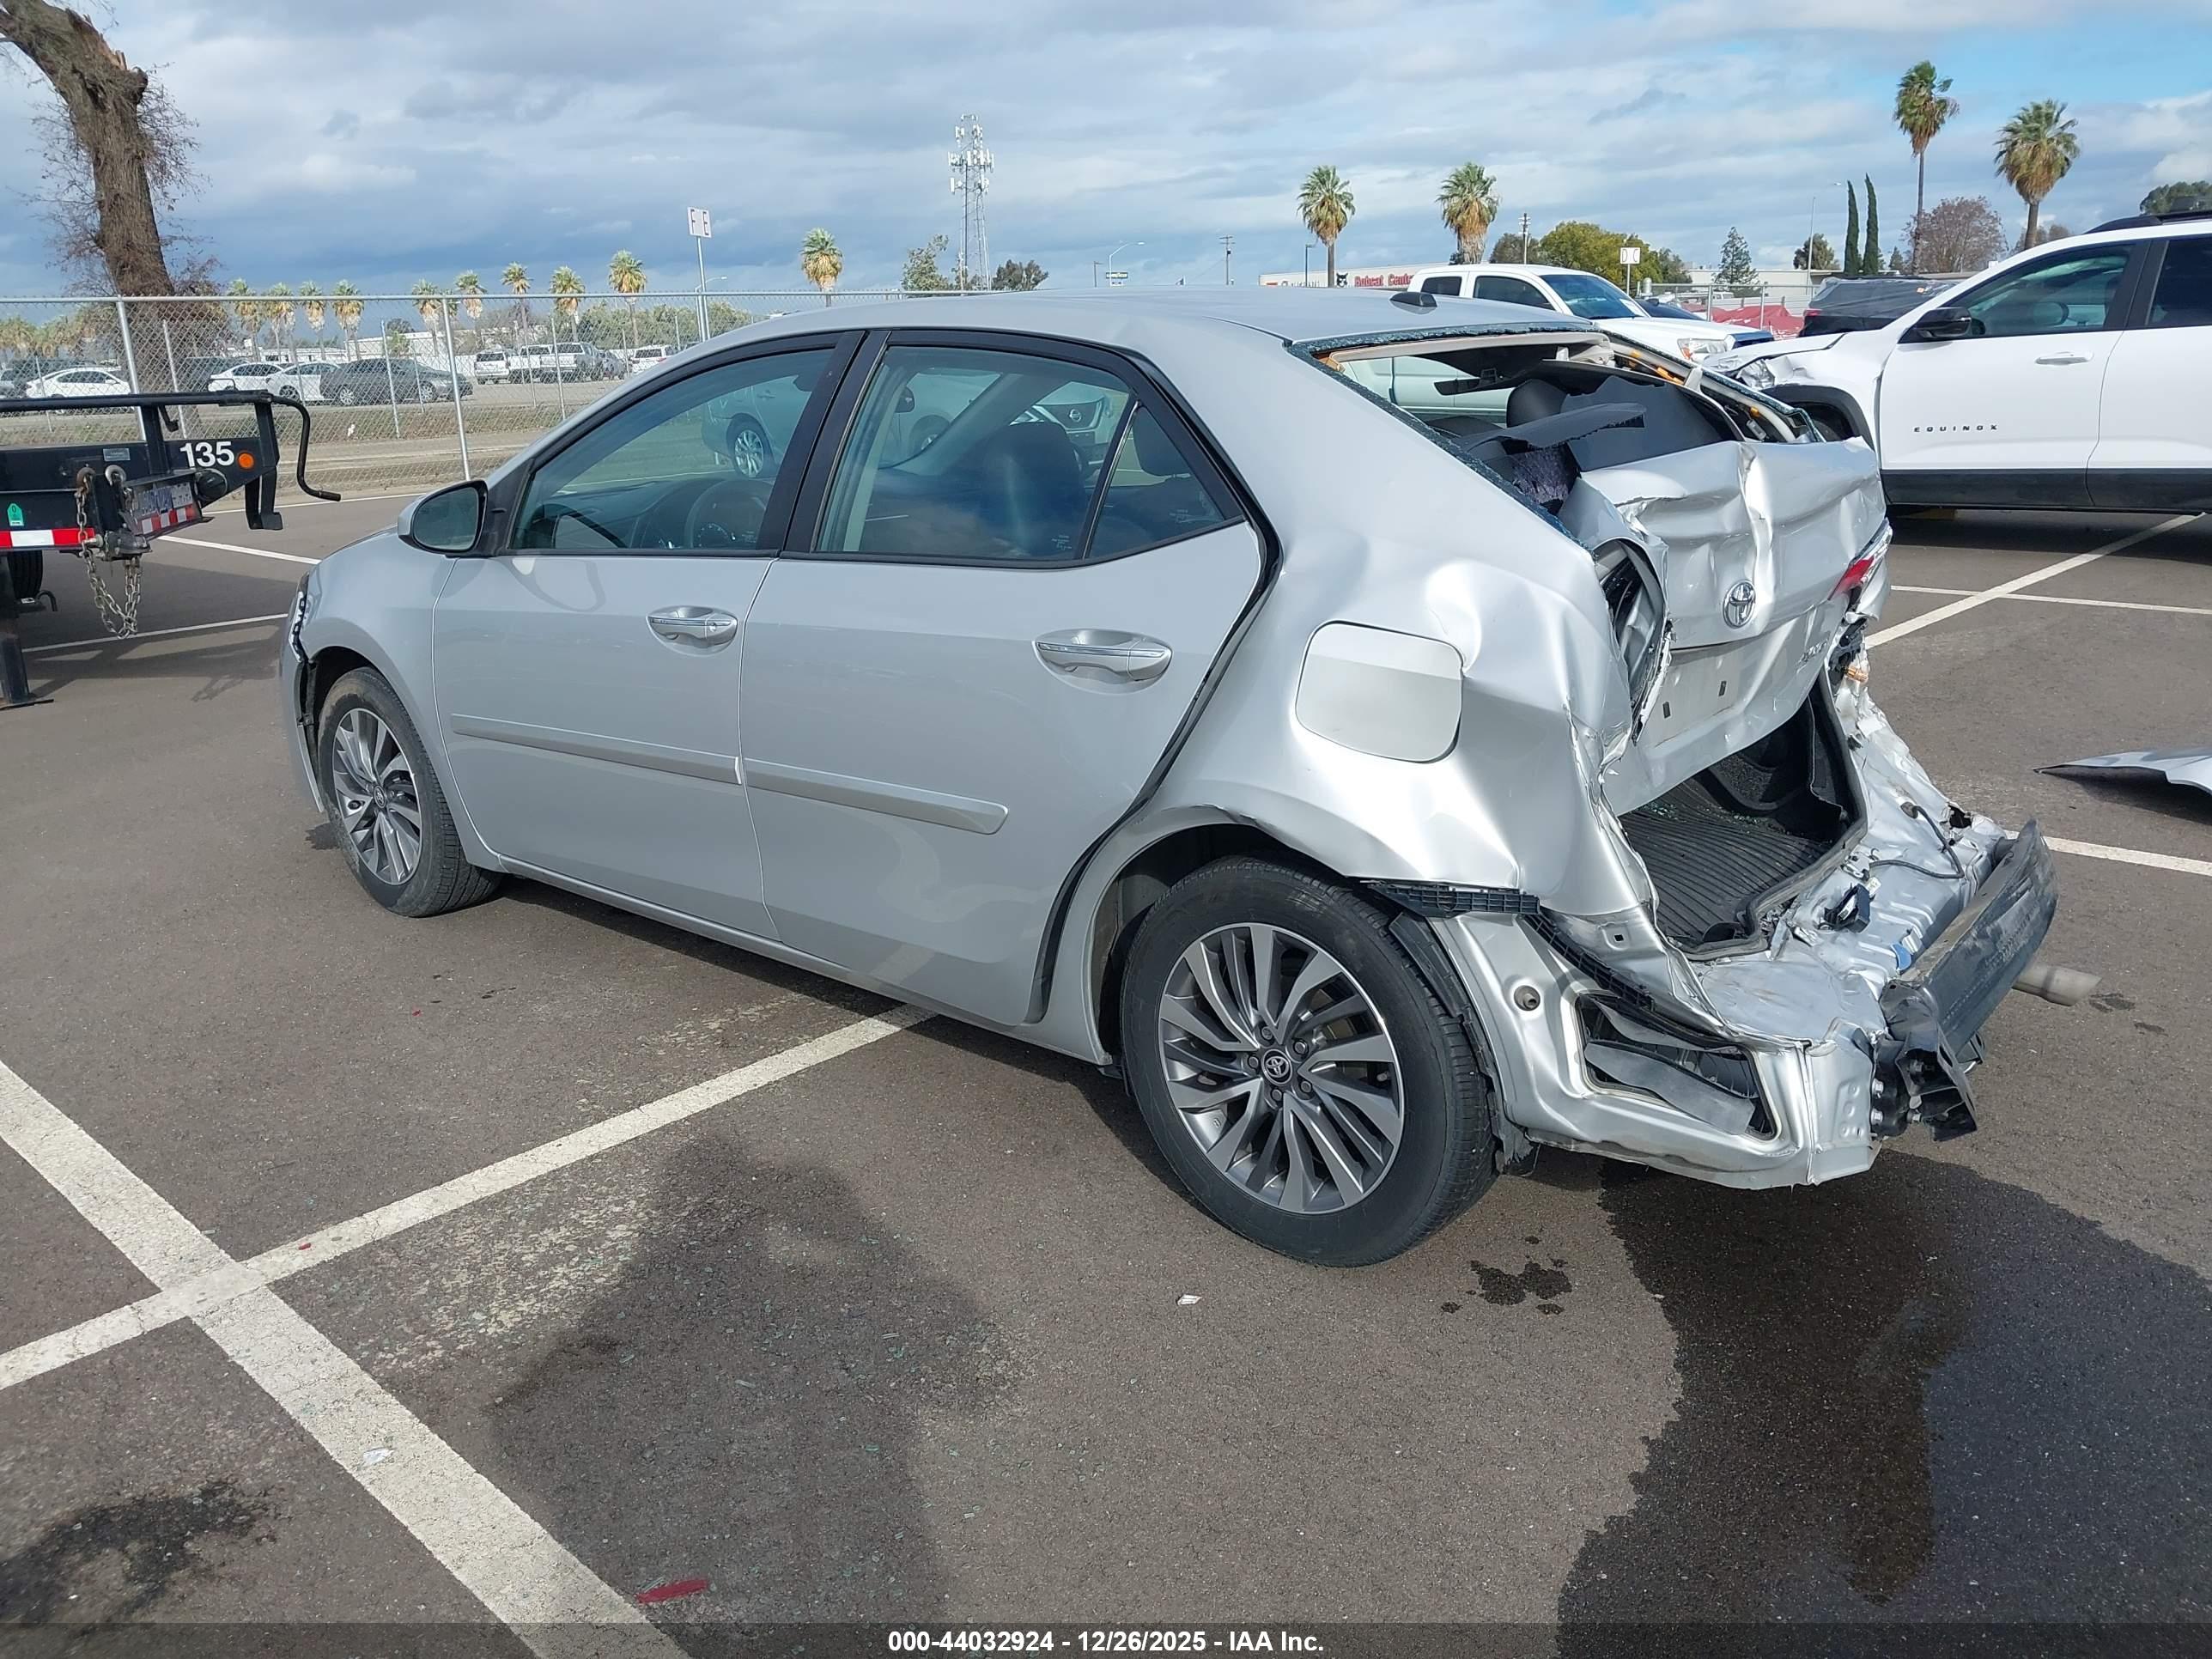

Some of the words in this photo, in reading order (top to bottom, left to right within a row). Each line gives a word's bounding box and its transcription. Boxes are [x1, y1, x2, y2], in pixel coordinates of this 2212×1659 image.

[702, 211, 709, 236] E
[1913, 424, 1998, 433] EQUINOX
[179, 441, 235, 468] 135
